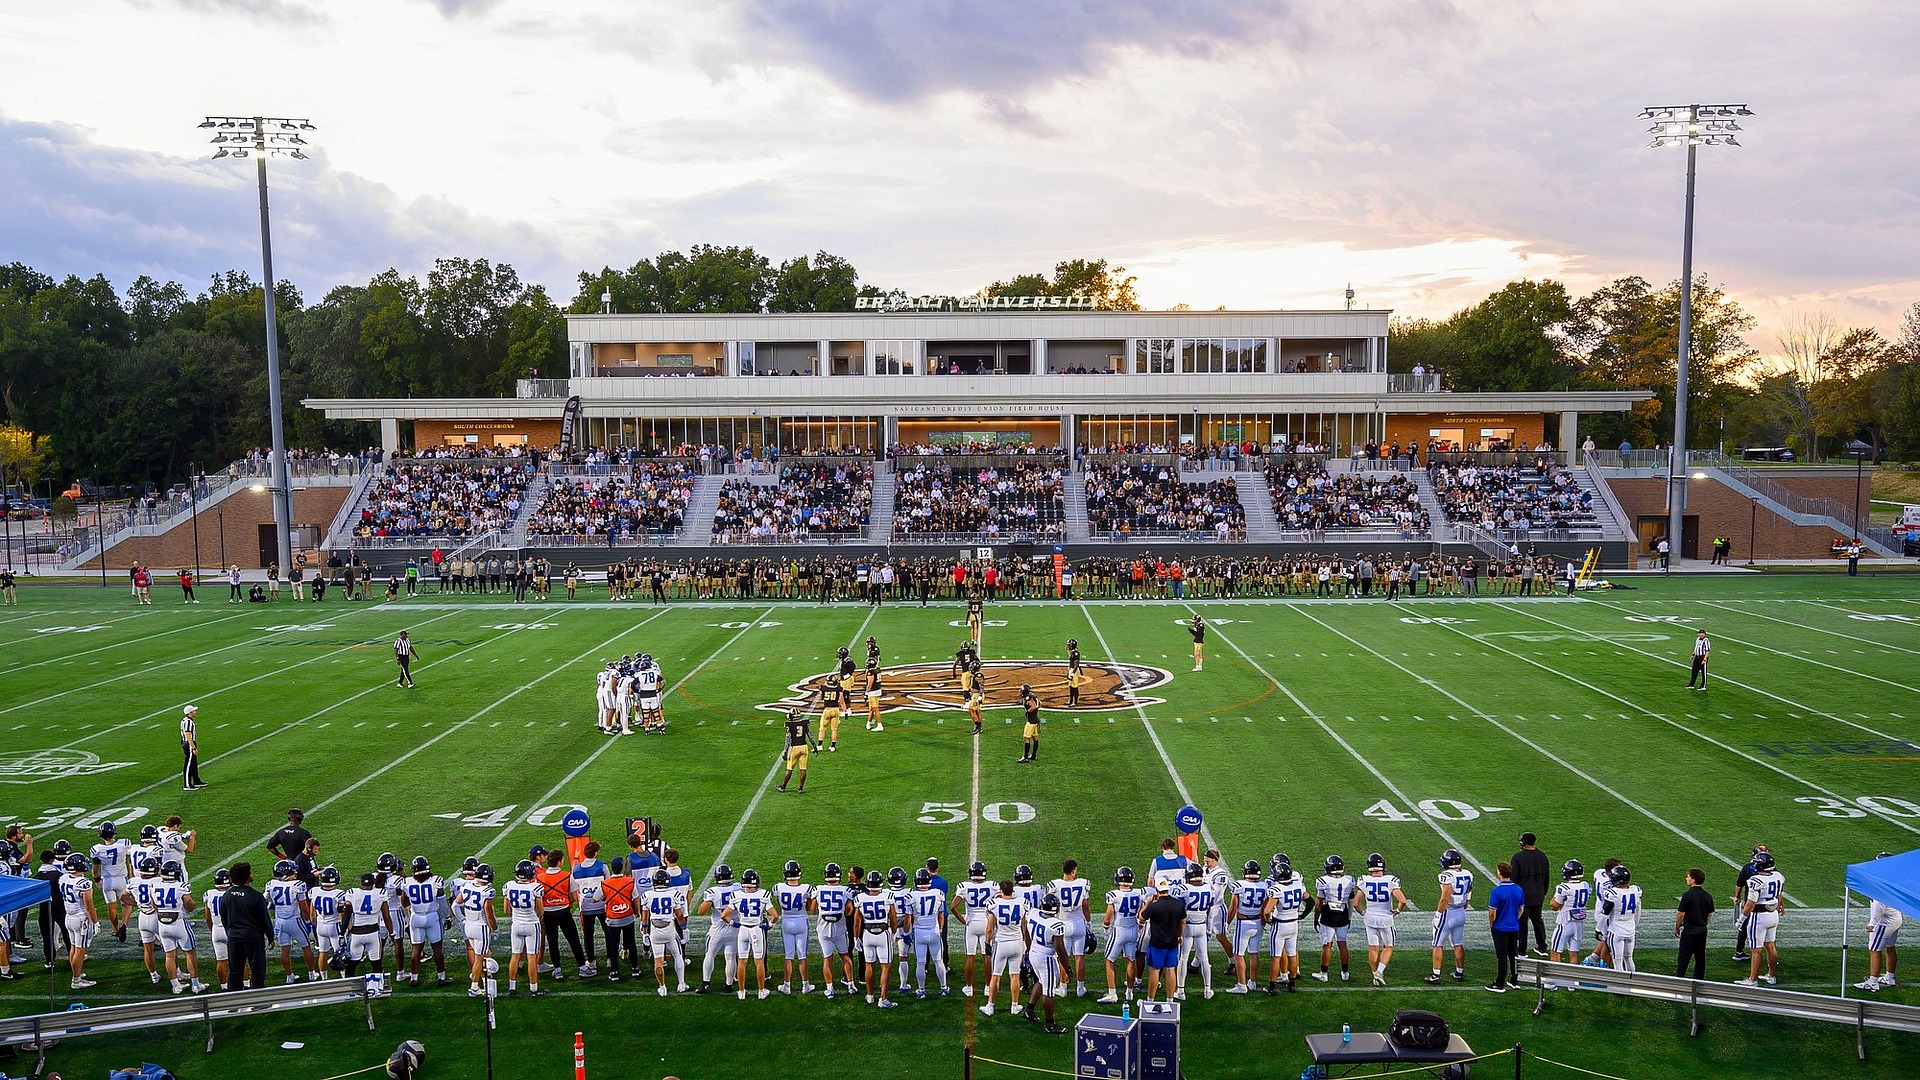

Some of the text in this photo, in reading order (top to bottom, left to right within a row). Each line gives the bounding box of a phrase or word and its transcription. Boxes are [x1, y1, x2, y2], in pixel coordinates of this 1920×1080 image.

[855, 296, 1100, 309] BRYANT UNIVERSITY
[979, 549, 990, 558] 12
[971, 604, 979, 612] 13
[964, 654, 971, 663] 5
[641, 671, 655, 684] 78
[823, 691, 837, 701] 50
[796, 725, 803, 738] 3
[461, 804, 589, 827] 40
[916, 802, 1037, 824] 50
[1362, 799, 1480, 822] 40
[1793, 796, 1920, 818] 30
[5, 806, 150, 830] 30
[567, 819, 587, 827] CAA
[1182, 815, 1199, 824] CAA
[632, 820, 646, 842] 2
[106, 847, 118, 866] 7
[133, 851, 147, 870] 12
[138, 884, 150, 904] 8
[409, 884, 434, 904] 90
[1336, 883, 1343, 901] 1
[1366, 882, 1389, 902] 35
[1453, 875, 1471, 896] 57
[1765, 880, 1781, 901] 91
[154, 888, 177, 909] 34
[272, 886, 292, 906] 21
[314, 896, 334, 915] 40
[360, 895, 373, 915] 4
[463, 888, 482, 911] 23
[509, 889, 532, 909] 83
[651, 897, 673, 915] 48
[781, 892, 804, 911] 94
[820, 890, 844, 911] 55
[919, 895, 935, 916] 17
[967, 887, 991, 908] 32
[1061, 886, 1083, 907] 97
[1187, 891, 1211, 911] 20
[1242, 888, 1266, 909] 33
[1283, 889, 1302, 910] 59
[1572, 888, 1589, 908] 10
[1620, 893, 1636, 915] 14
[611, 903, 628, 912] CAA
[739, 898, 761, 917] 43
[862, 901, 885, 921] 56
[998, 904, 1021, 925] 54
[1119, 896, 1140, 917] 49
[1029, 918, 1046, 946] 79
